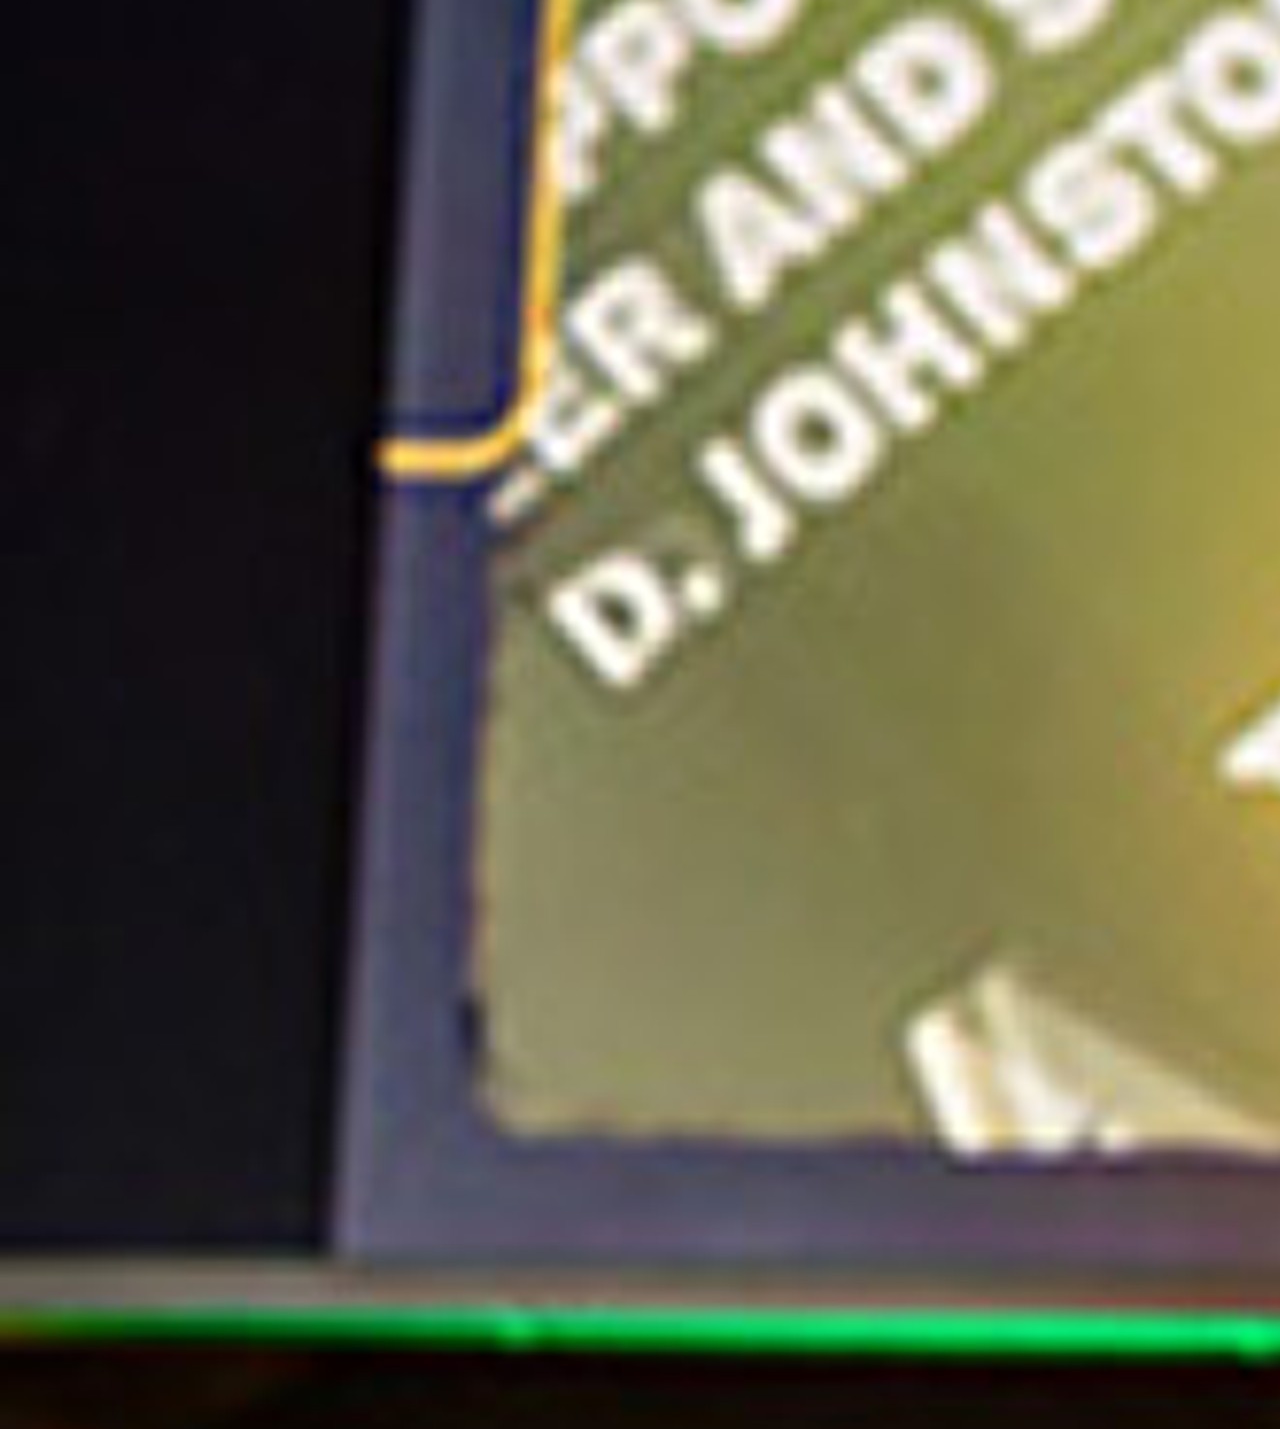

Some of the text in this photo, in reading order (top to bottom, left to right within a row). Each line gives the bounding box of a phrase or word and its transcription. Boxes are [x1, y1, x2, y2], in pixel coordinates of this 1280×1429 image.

[487, 254, 712, 524] ER
[695, 8, 994, 312] AND
[546, 544, 722, 689] D.
